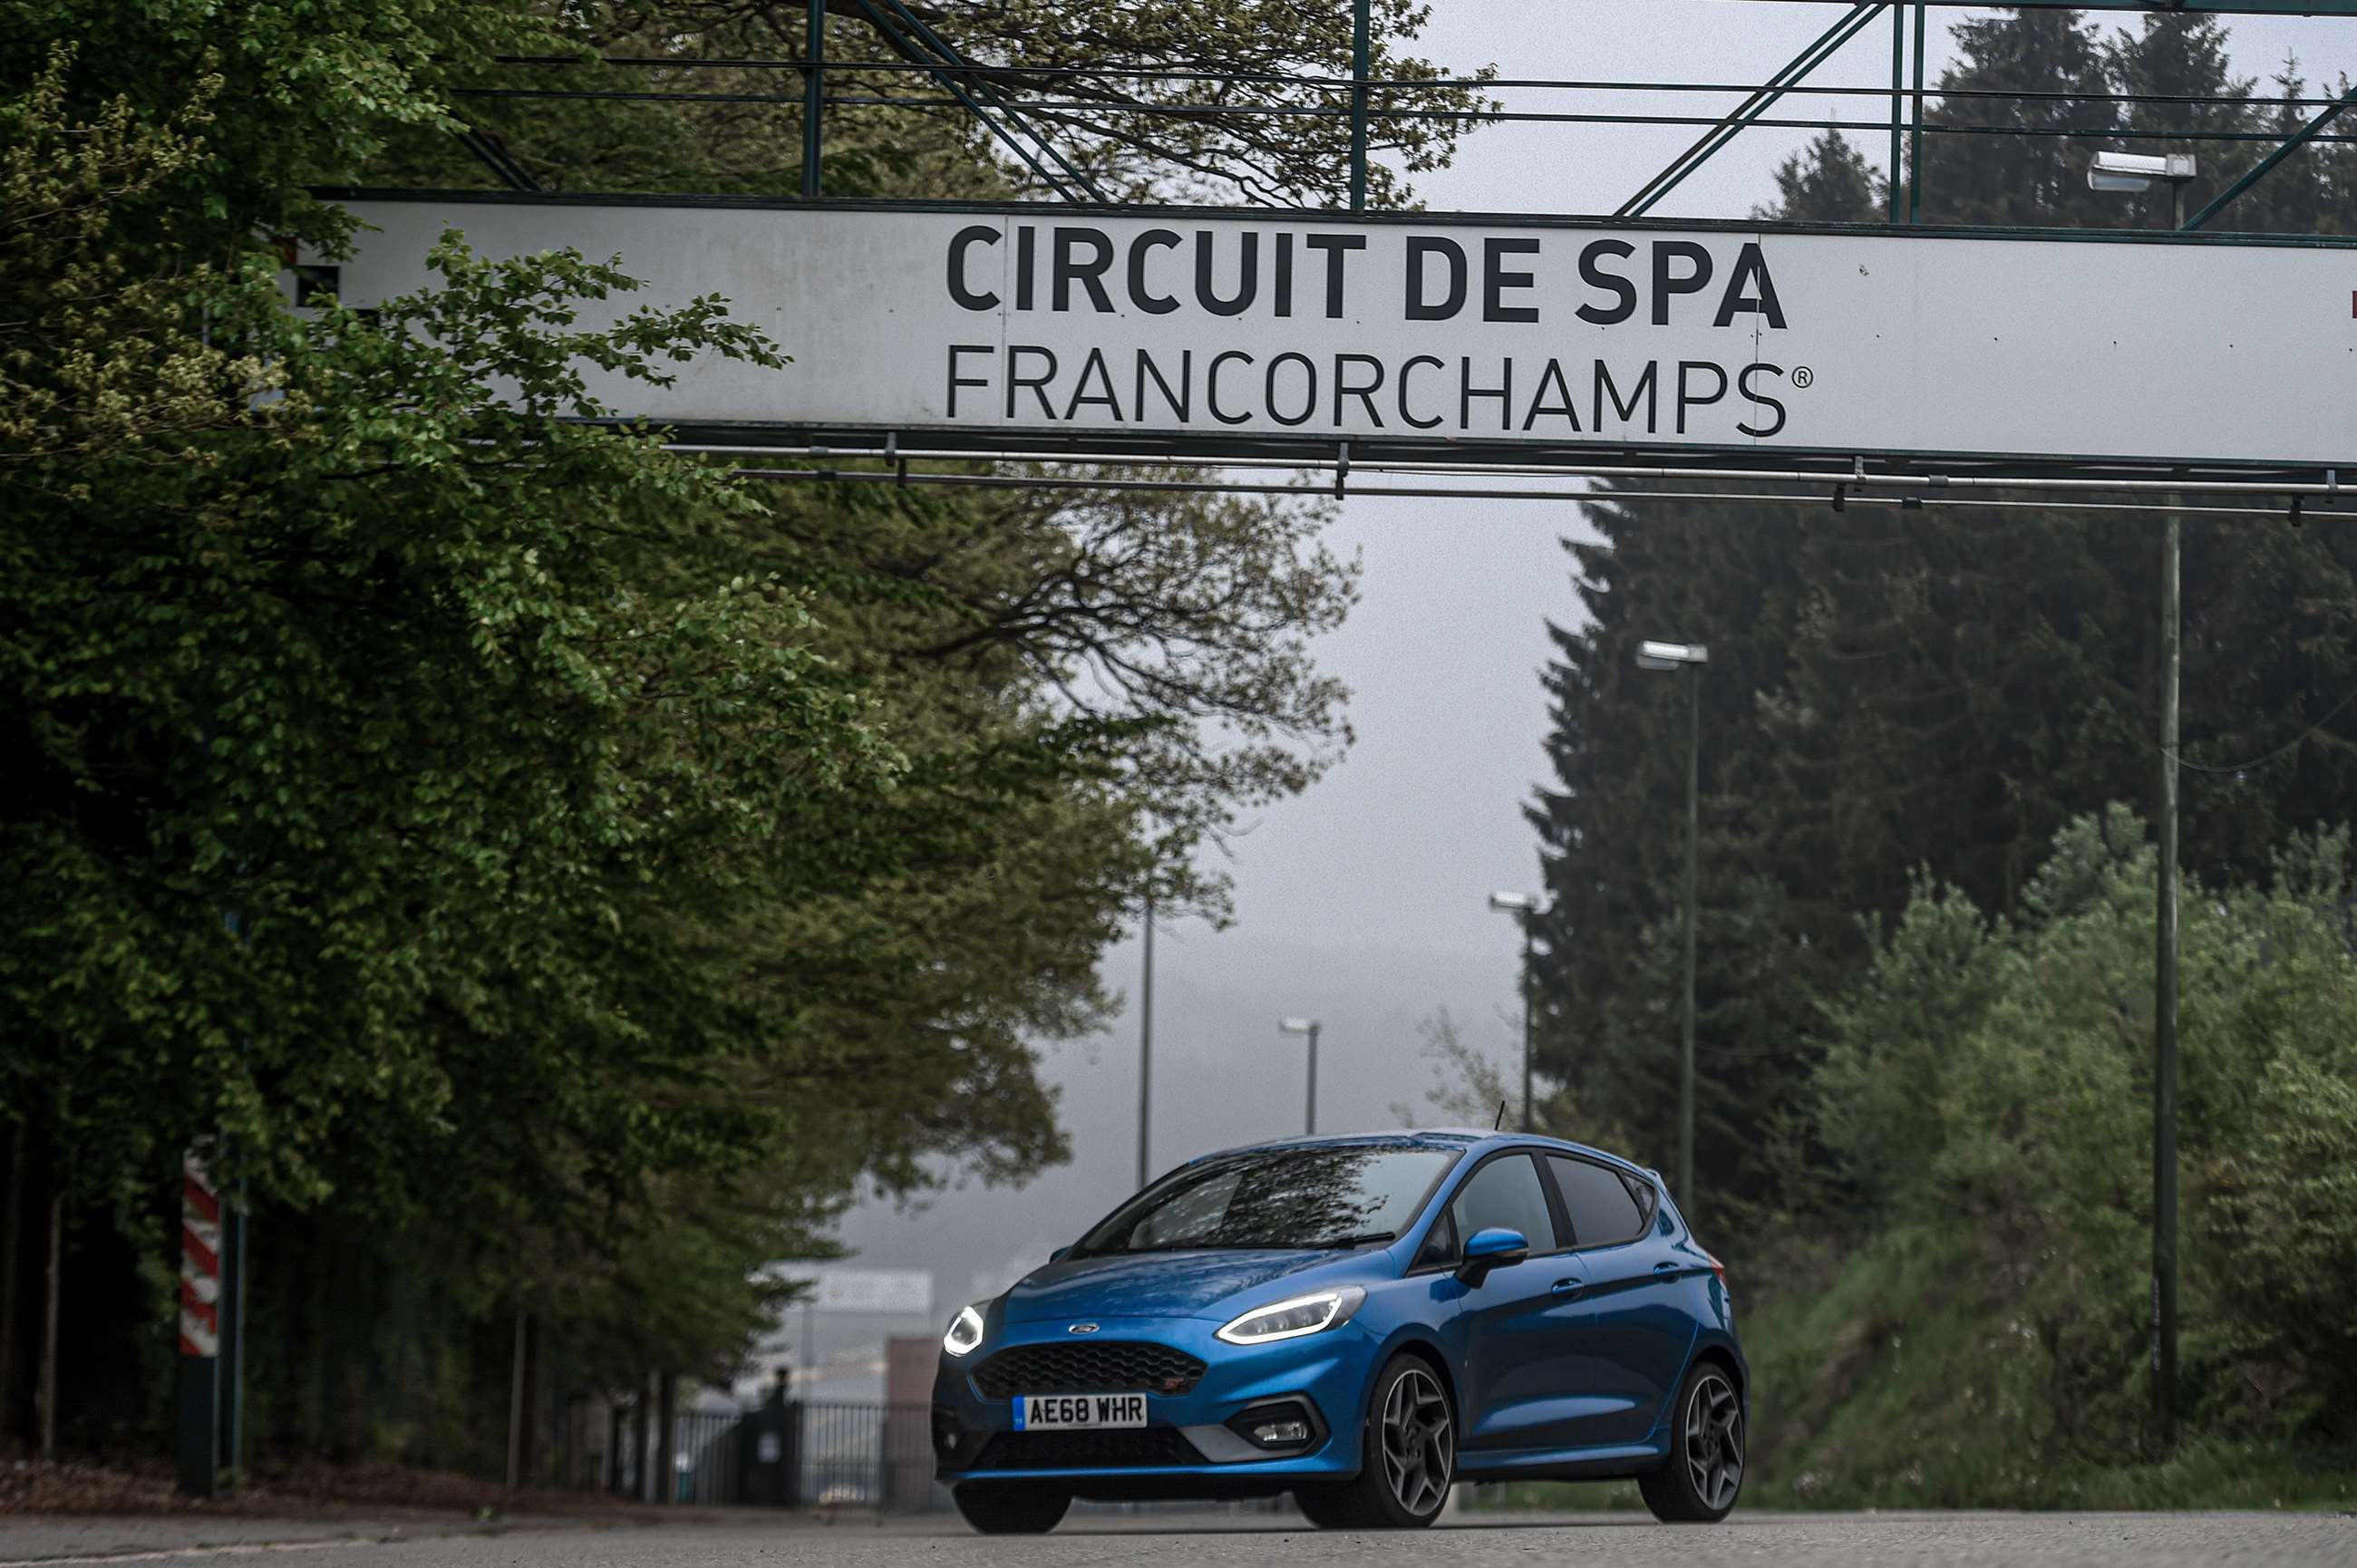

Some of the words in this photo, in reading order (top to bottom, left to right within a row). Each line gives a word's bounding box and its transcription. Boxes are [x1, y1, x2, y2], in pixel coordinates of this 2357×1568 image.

[947, 225, 1367, 319] CIRCUIT
[1404, 236, 1540, 324] DE
[1575, 239, 1788, 330] SPA
[1030, 1399, 1090, 1424] AE68
[1096, 1397, 1142, 1422] WHR
